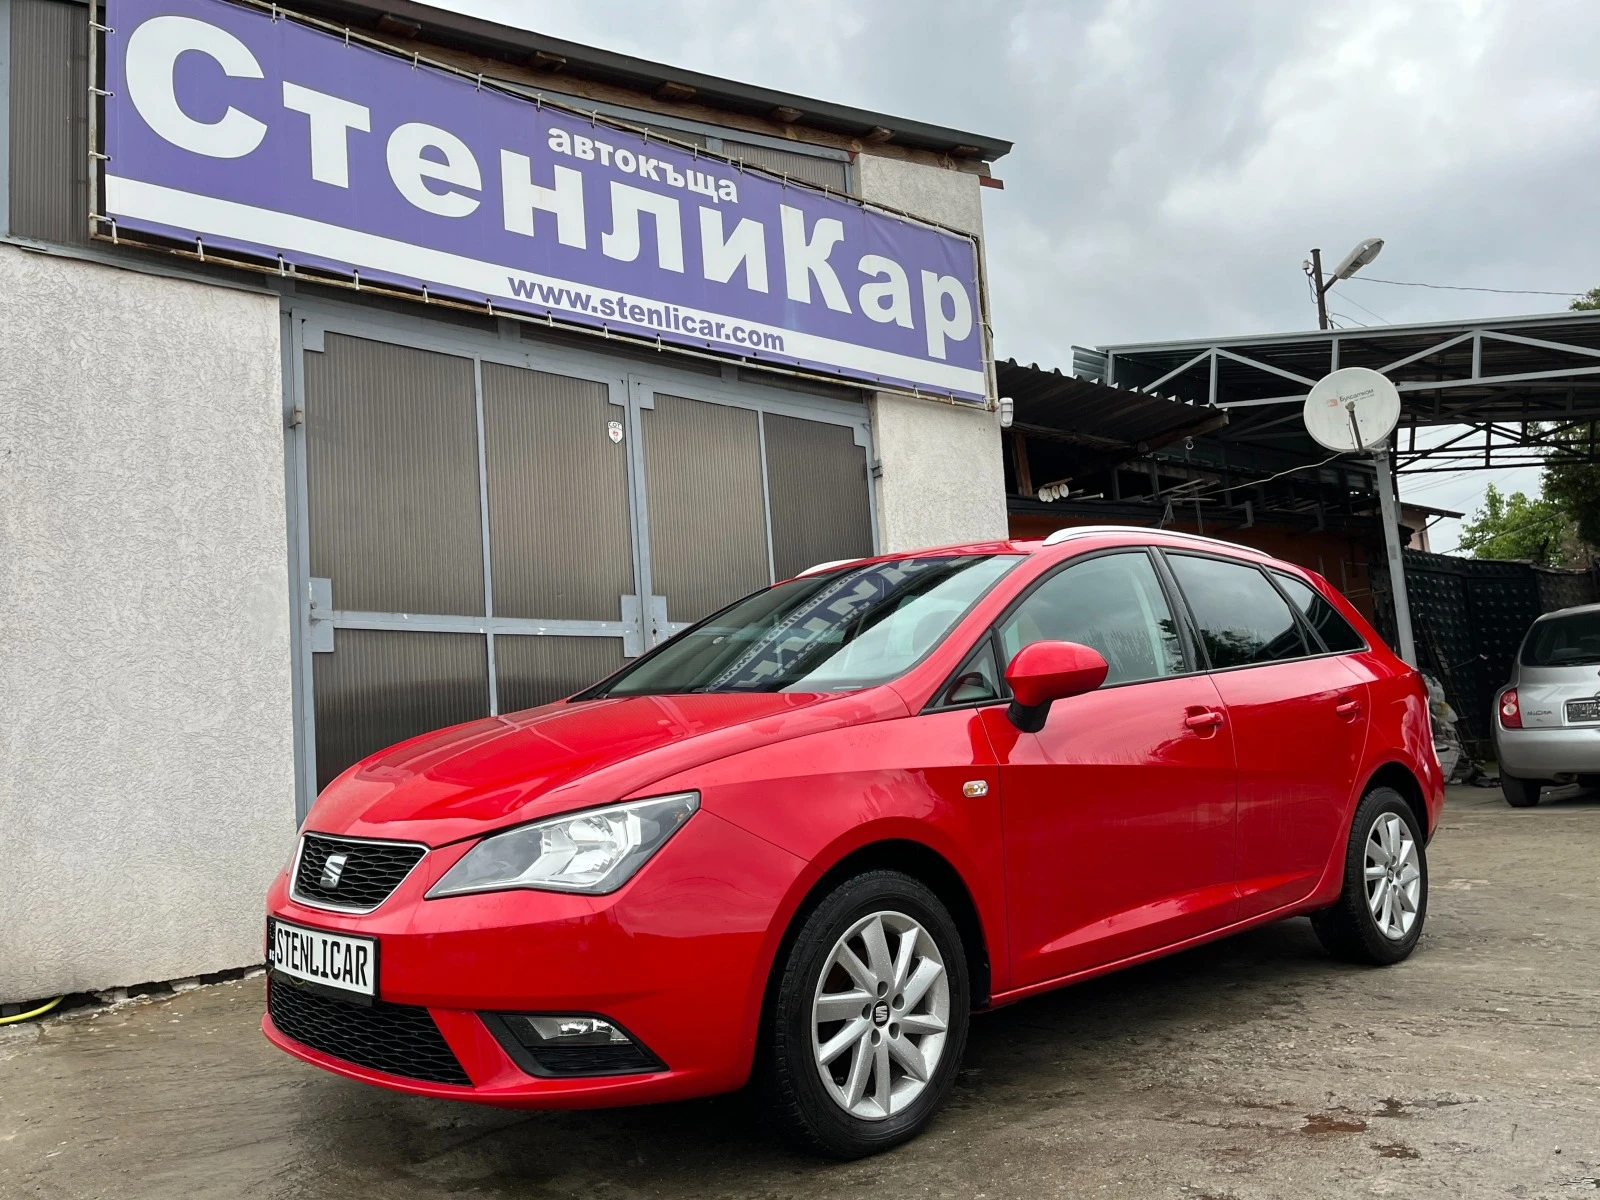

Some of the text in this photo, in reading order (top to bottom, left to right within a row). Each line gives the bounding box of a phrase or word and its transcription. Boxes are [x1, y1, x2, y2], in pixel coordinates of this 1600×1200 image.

[125, 15, 971, 359] СтенлиКар
[548, 128, 738, 203] автокъща
[508, 277, 785, 351] www.stenlicar.com
[276, 927, 368, 987] STENLICAR
